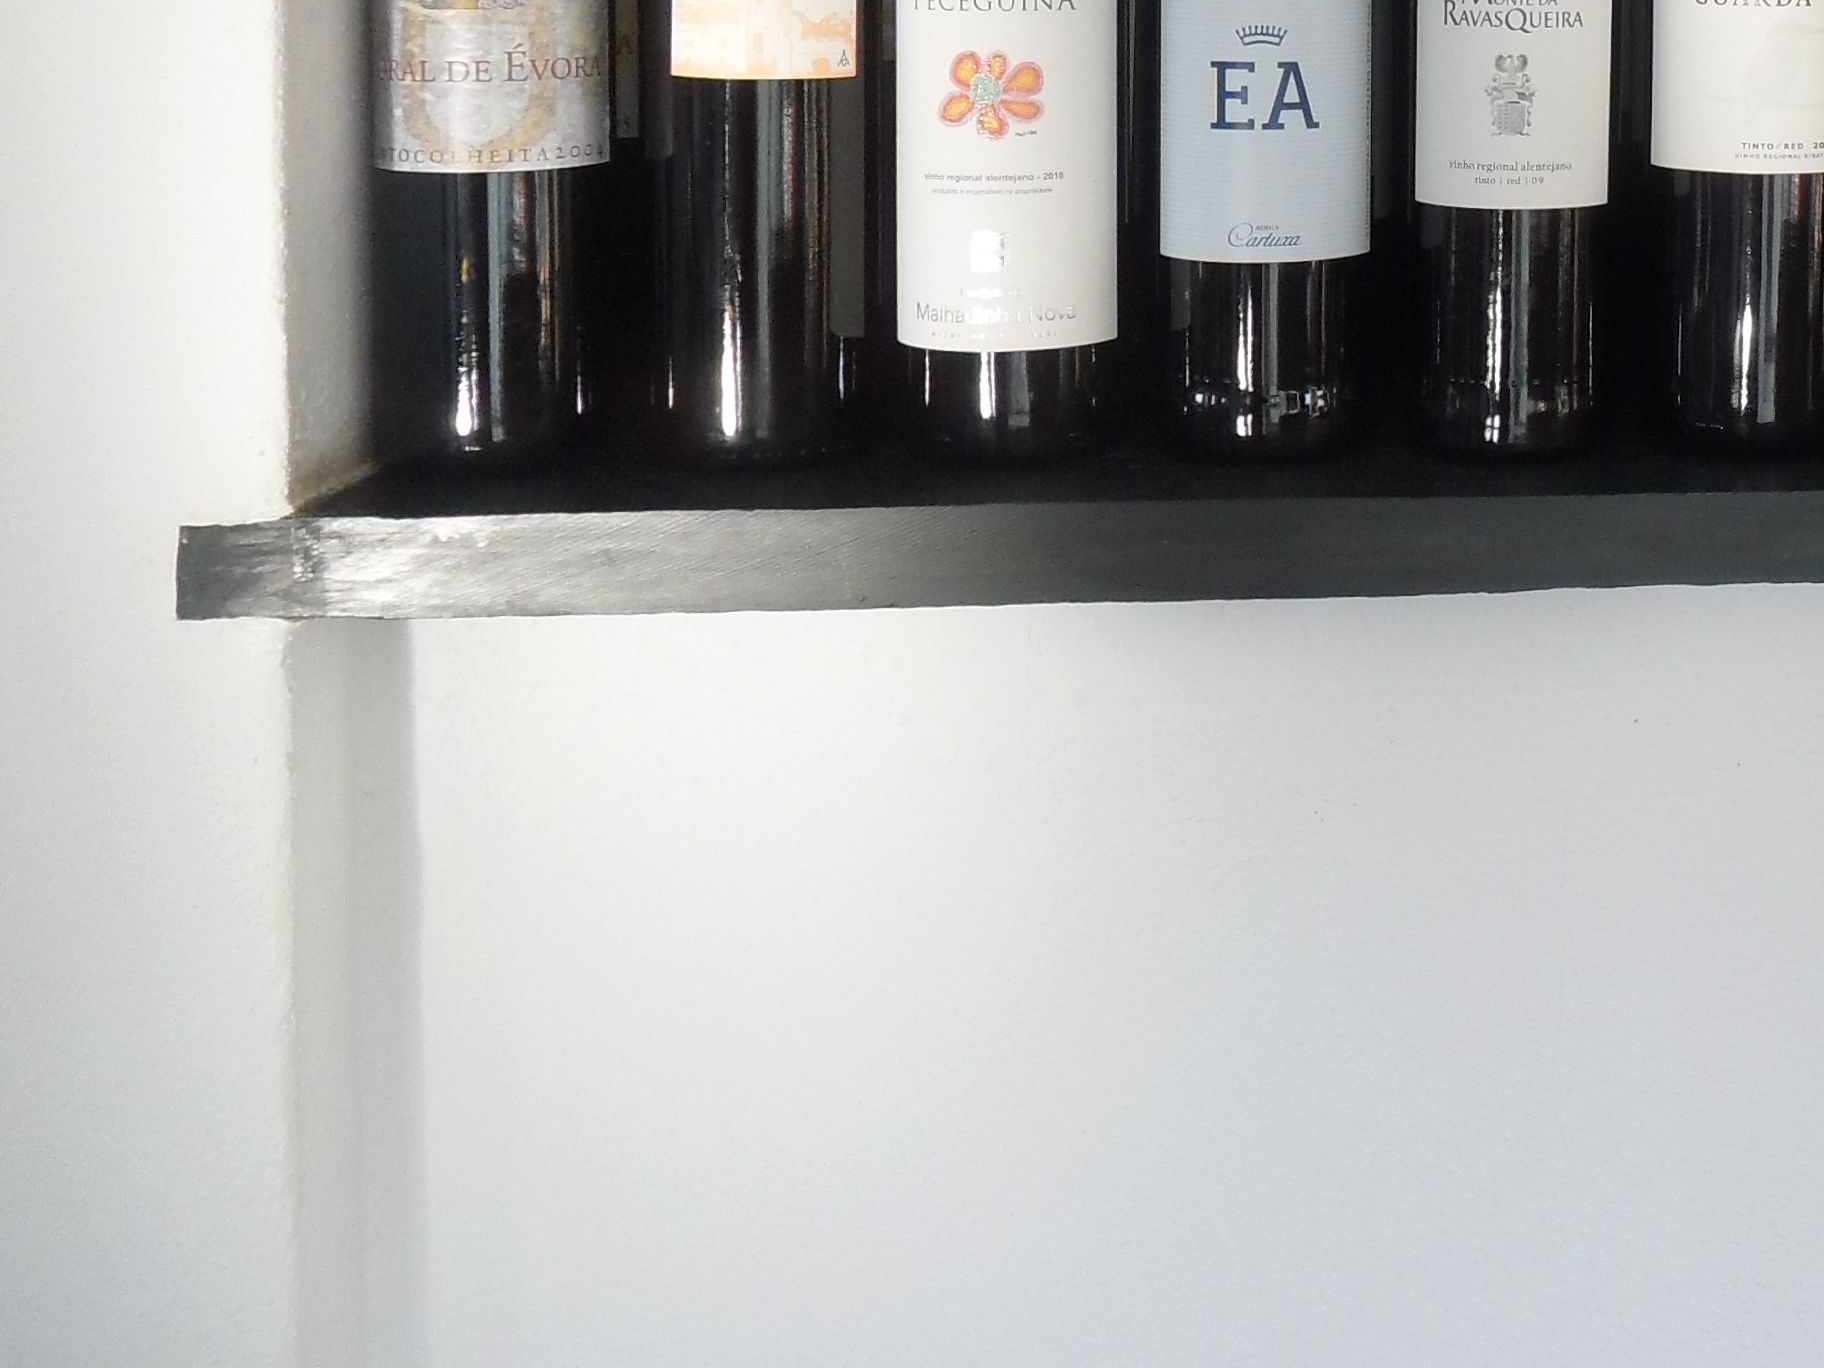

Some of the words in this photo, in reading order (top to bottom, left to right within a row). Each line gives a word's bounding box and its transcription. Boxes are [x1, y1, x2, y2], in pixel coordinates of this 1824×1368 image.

[445, 60, 492, 82] DE
[503, 42, 601, 83] ÉVORA
[1210, 61, 1320, 130] EA
[1449, 159, 1475, 170] vinho
[1476, 161, 1518, 173] regional
[1520, 161, 1572, 173] alentejano
[946, 172, 982, 183] regional
[1474, 175, 1496, 185] tinto
[1506, 176, 1521, 185] red
[1227, 222, 1301, 248] Cartuxa
